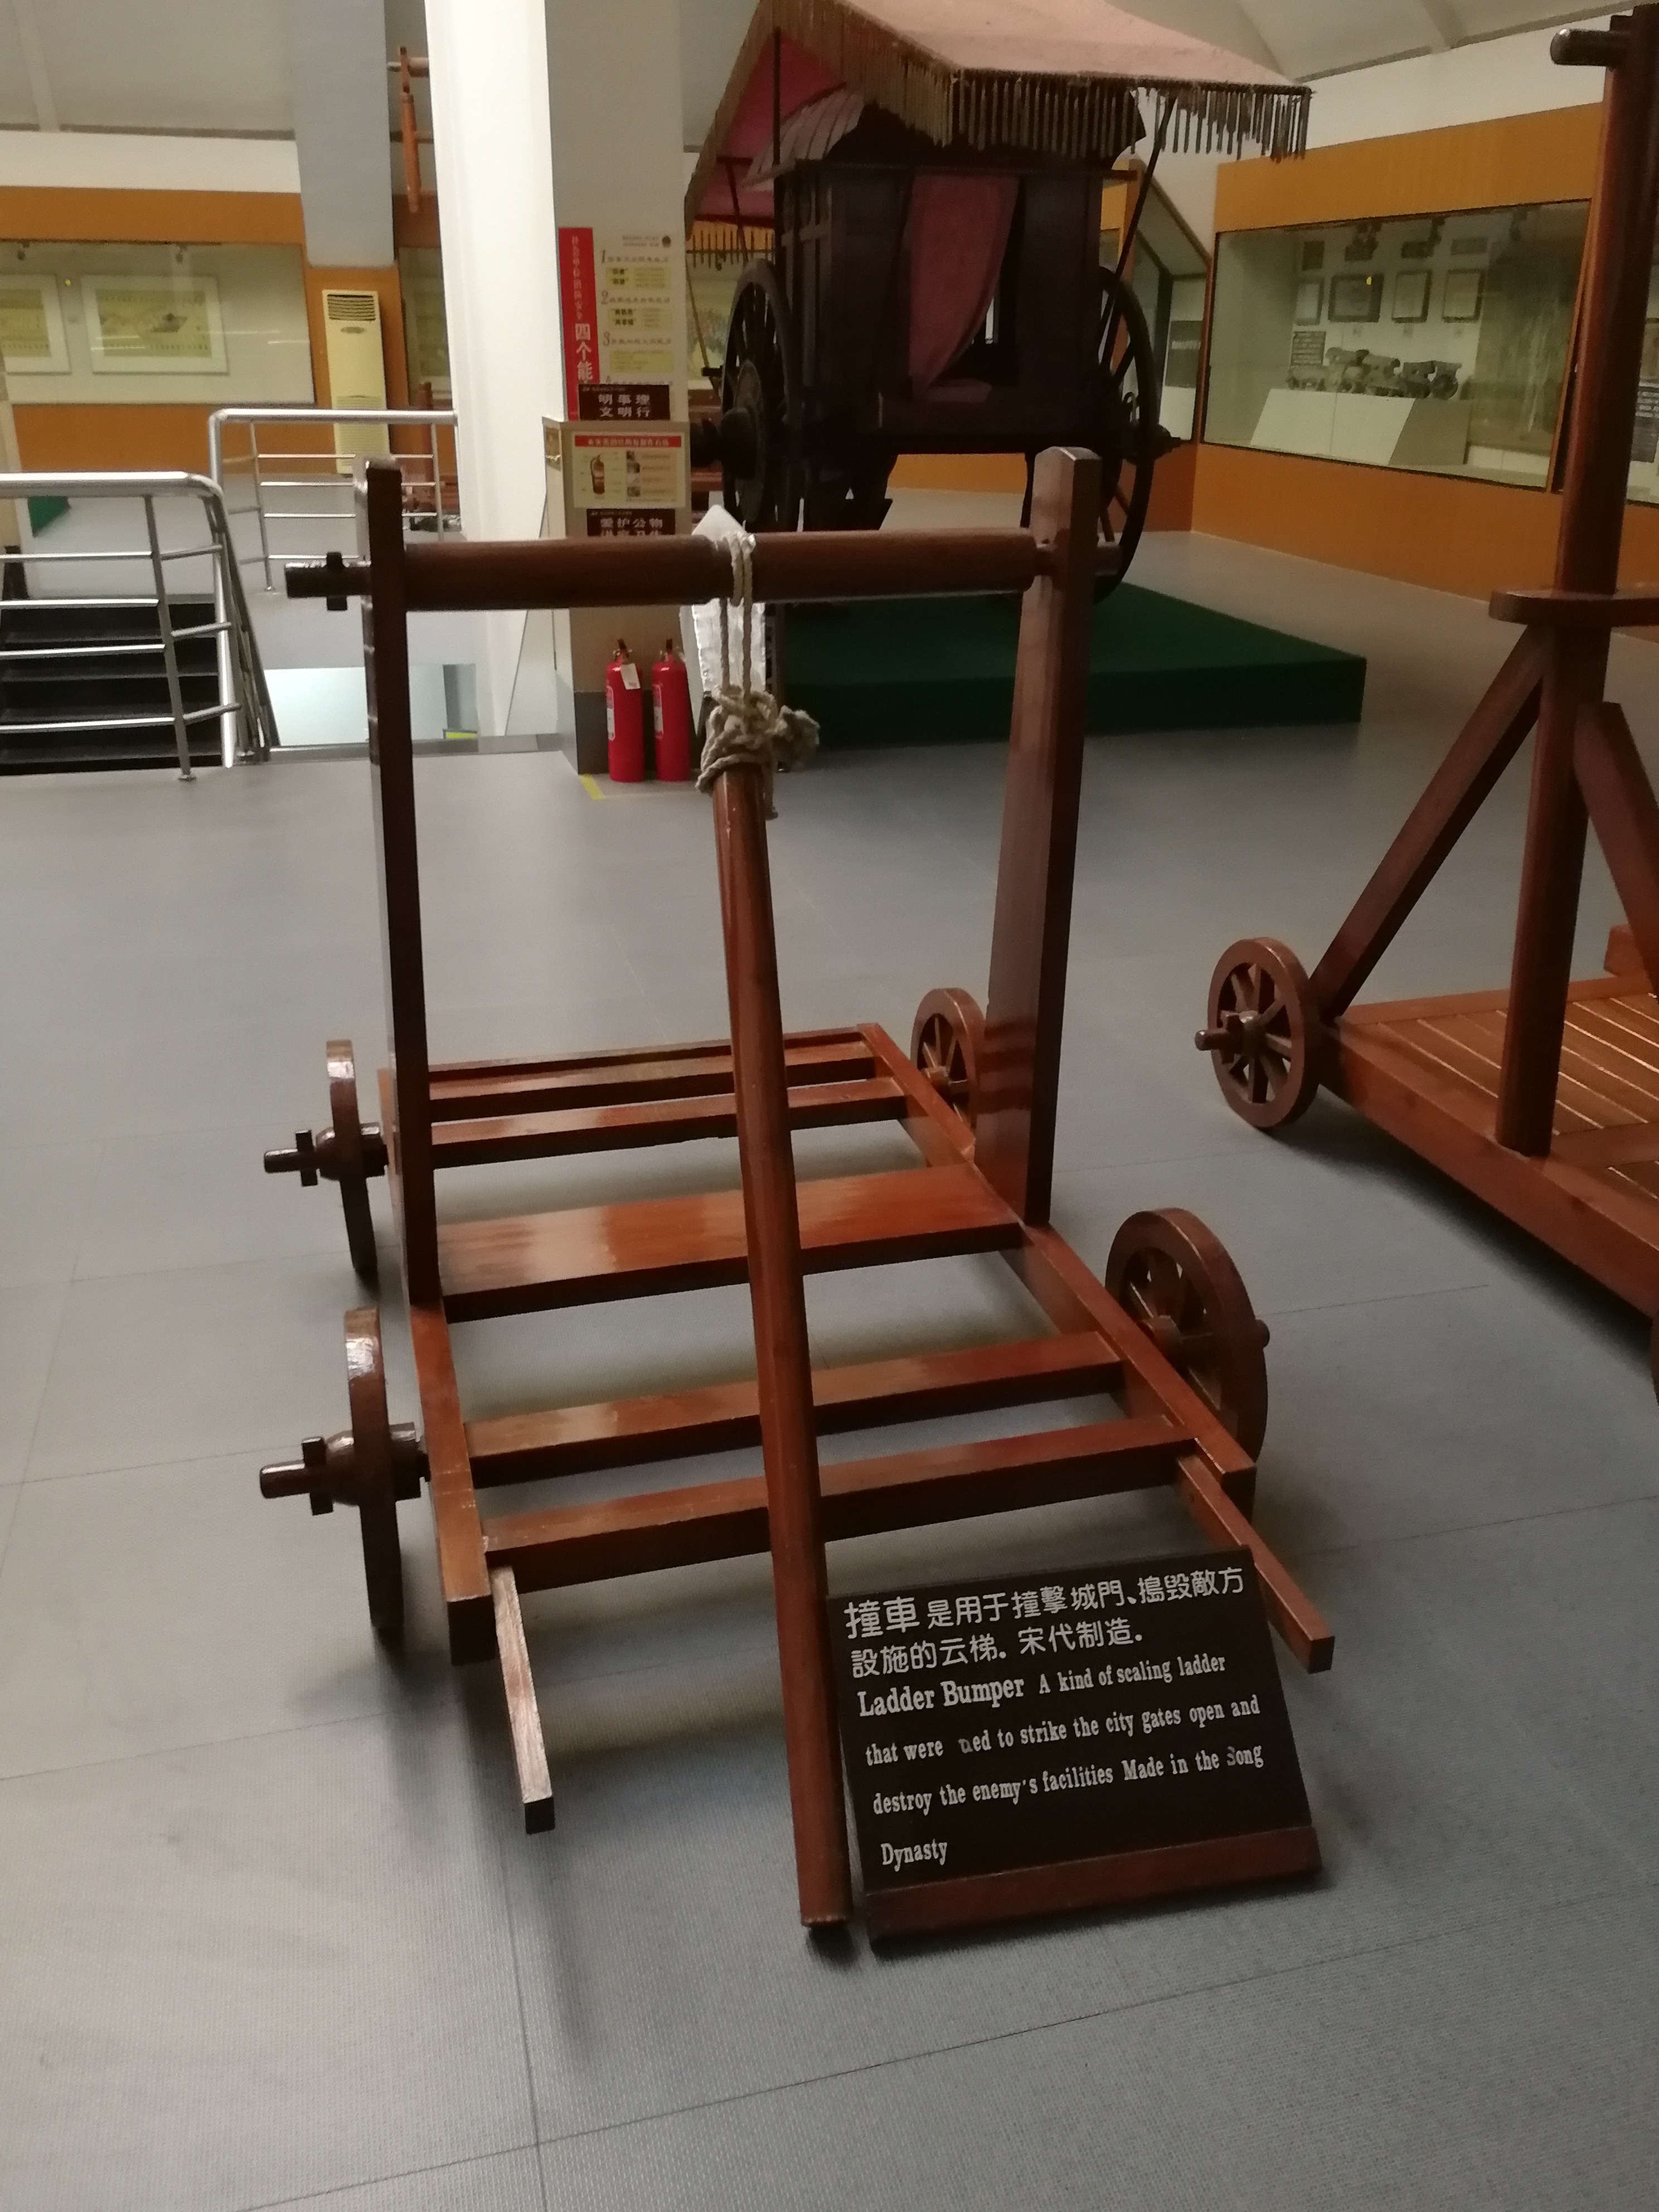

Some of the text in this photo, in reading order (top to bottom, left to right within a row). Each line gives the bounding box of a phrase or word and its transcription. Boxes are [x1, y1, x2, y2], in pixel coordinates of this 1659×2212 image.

[843, 1595, 920, 1639] 撞車
[857, 1653, 1225, 1717] Ladder Bumper A kind of scaling ladder
[865, 1743, 899, 1766] that
[903, 1740, 944, 1760] were
[997, 1729, 1014, 1748] to
[1020, 1720, 1067, 1745] strike
[1073, 1716, 1099, 1738] the
[1105, 1711, 1133, 1737] city
[1141, 1708, 1181, 1734] gates
[1189, 1704, 1225, 1728] open
[1230, 1694, 1260, 1717] and
[873, 1745, 1264, 1816] destroy the enemy's facilities Made in the Song
[880, 1839, 948, 1872] Dynasty
